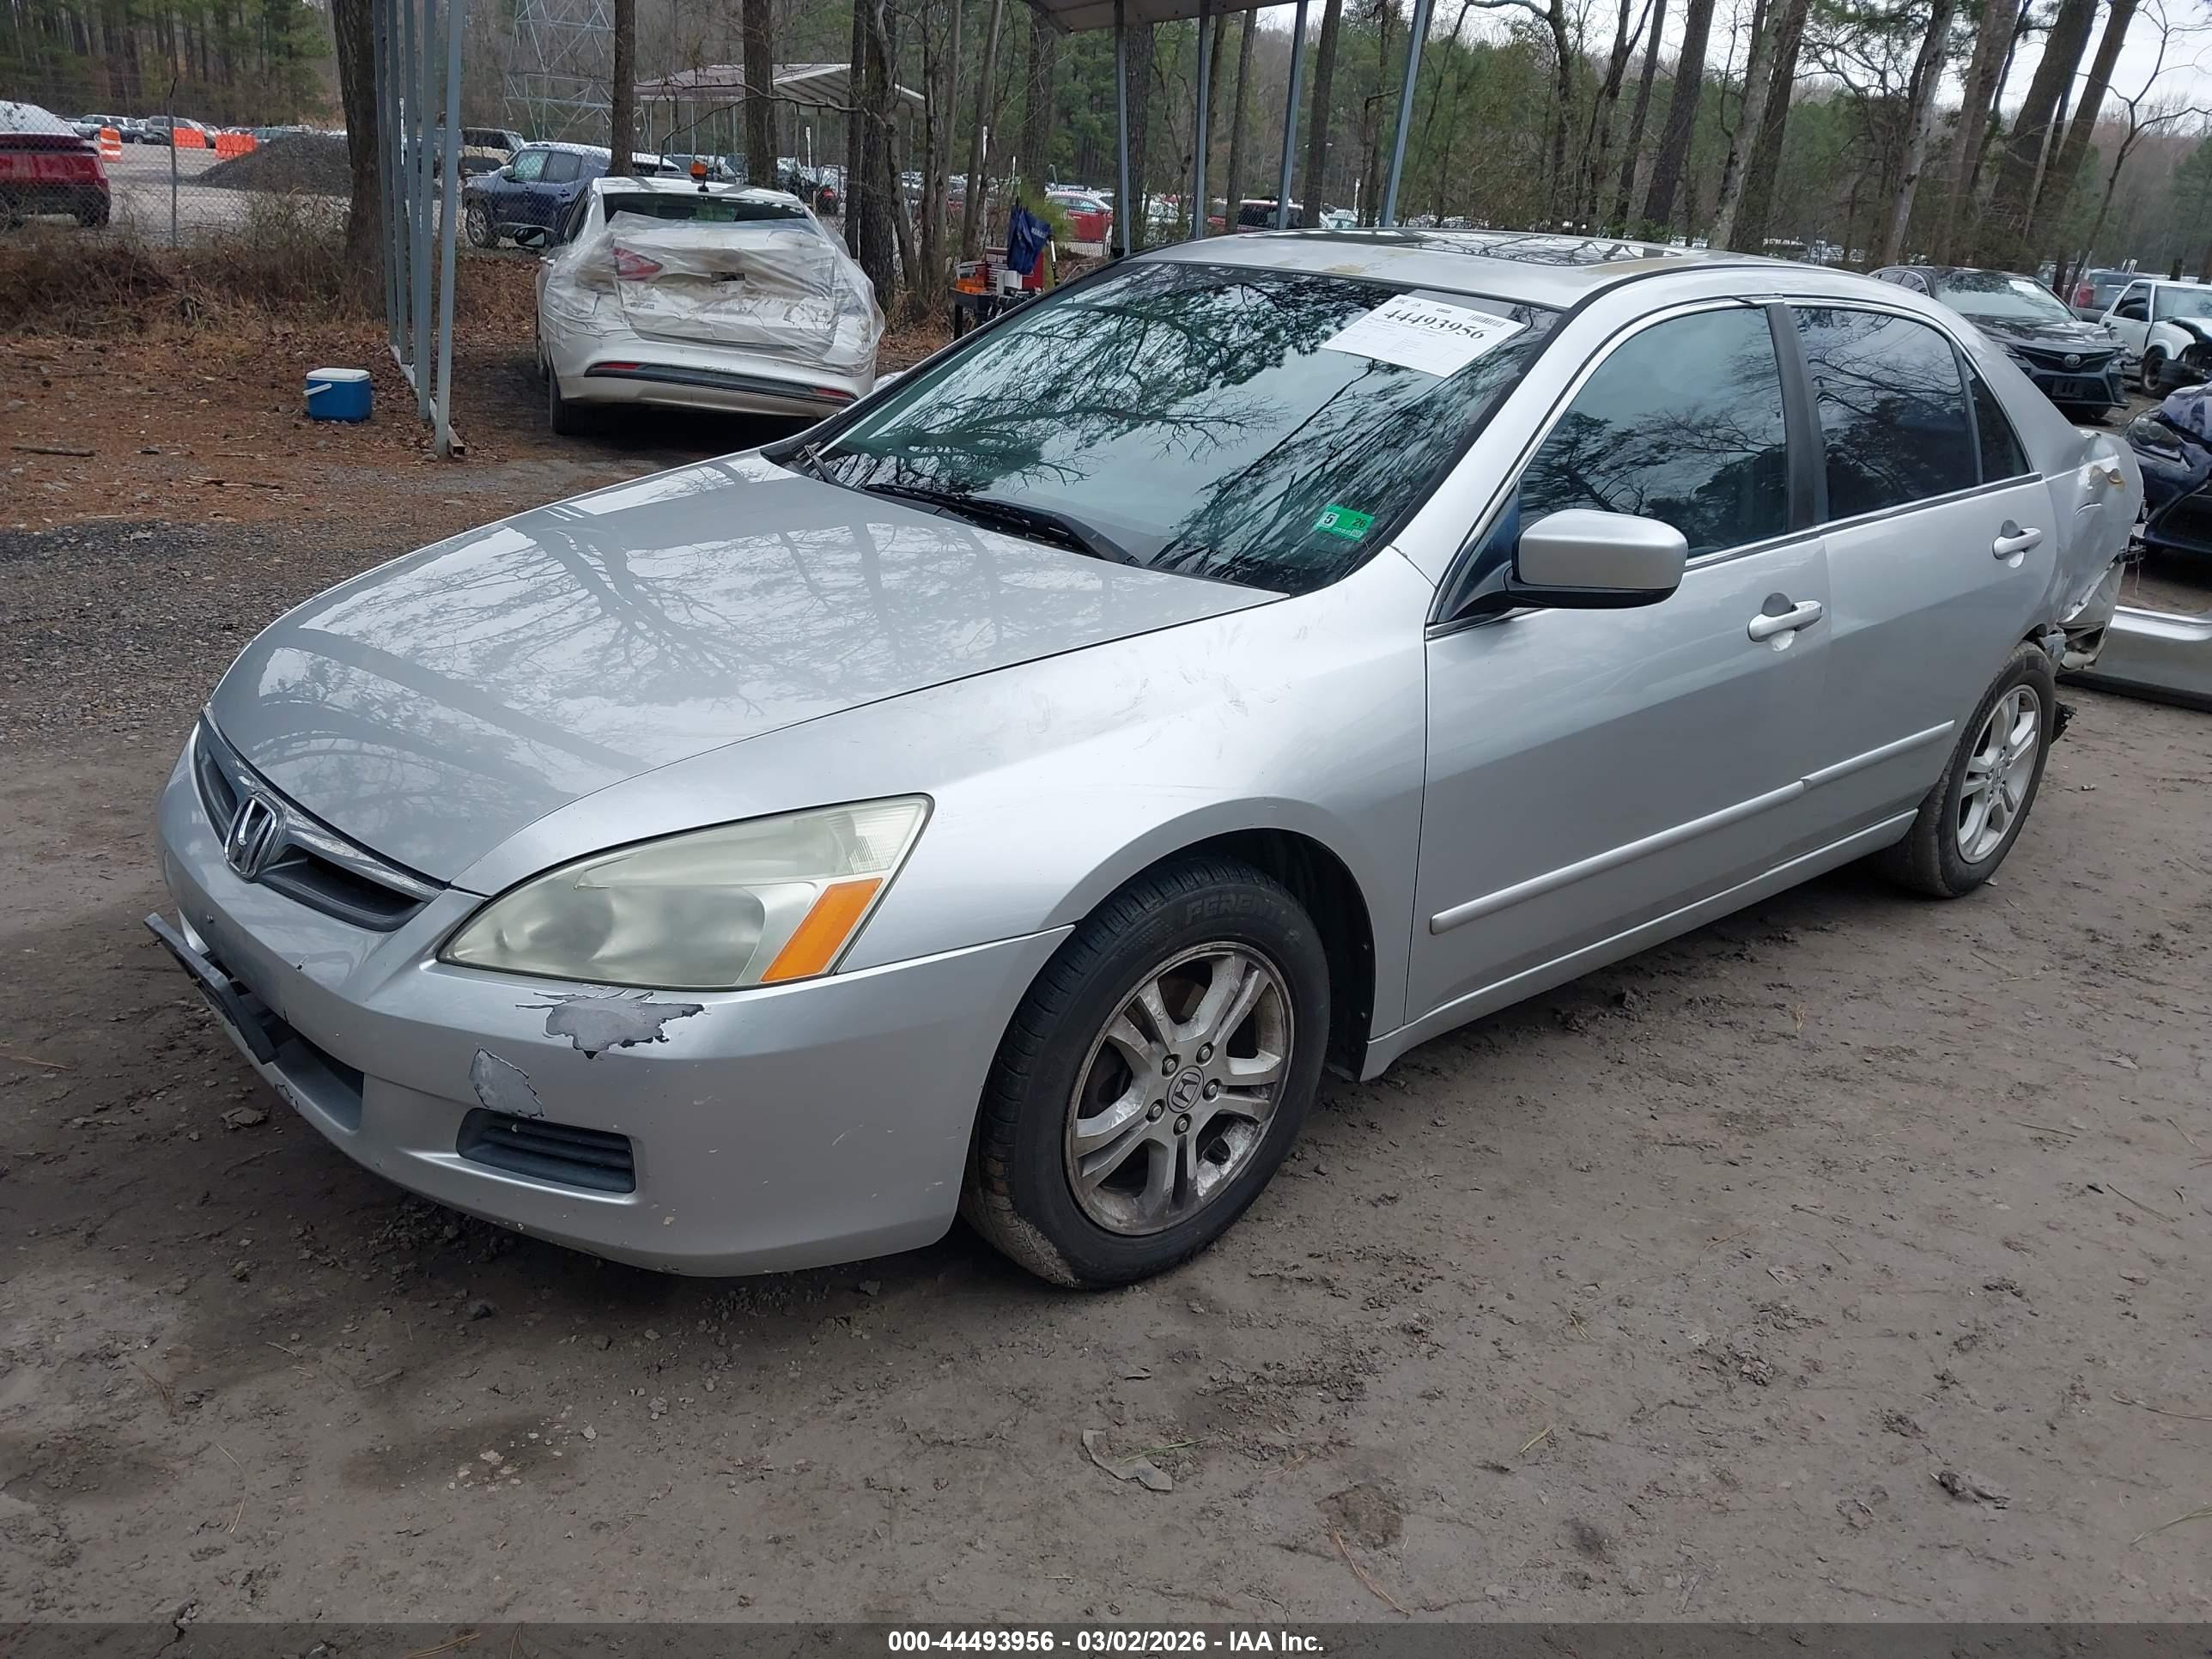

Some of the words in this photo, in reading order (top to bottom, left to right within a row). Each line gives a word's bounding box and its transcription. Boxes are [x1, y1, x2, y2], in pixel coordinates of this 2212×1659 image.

[1384, 310, 1490, 340] 44493956
[1325, 514, 1335, 524] 5
[1352, 519, 1366, 528] 26
